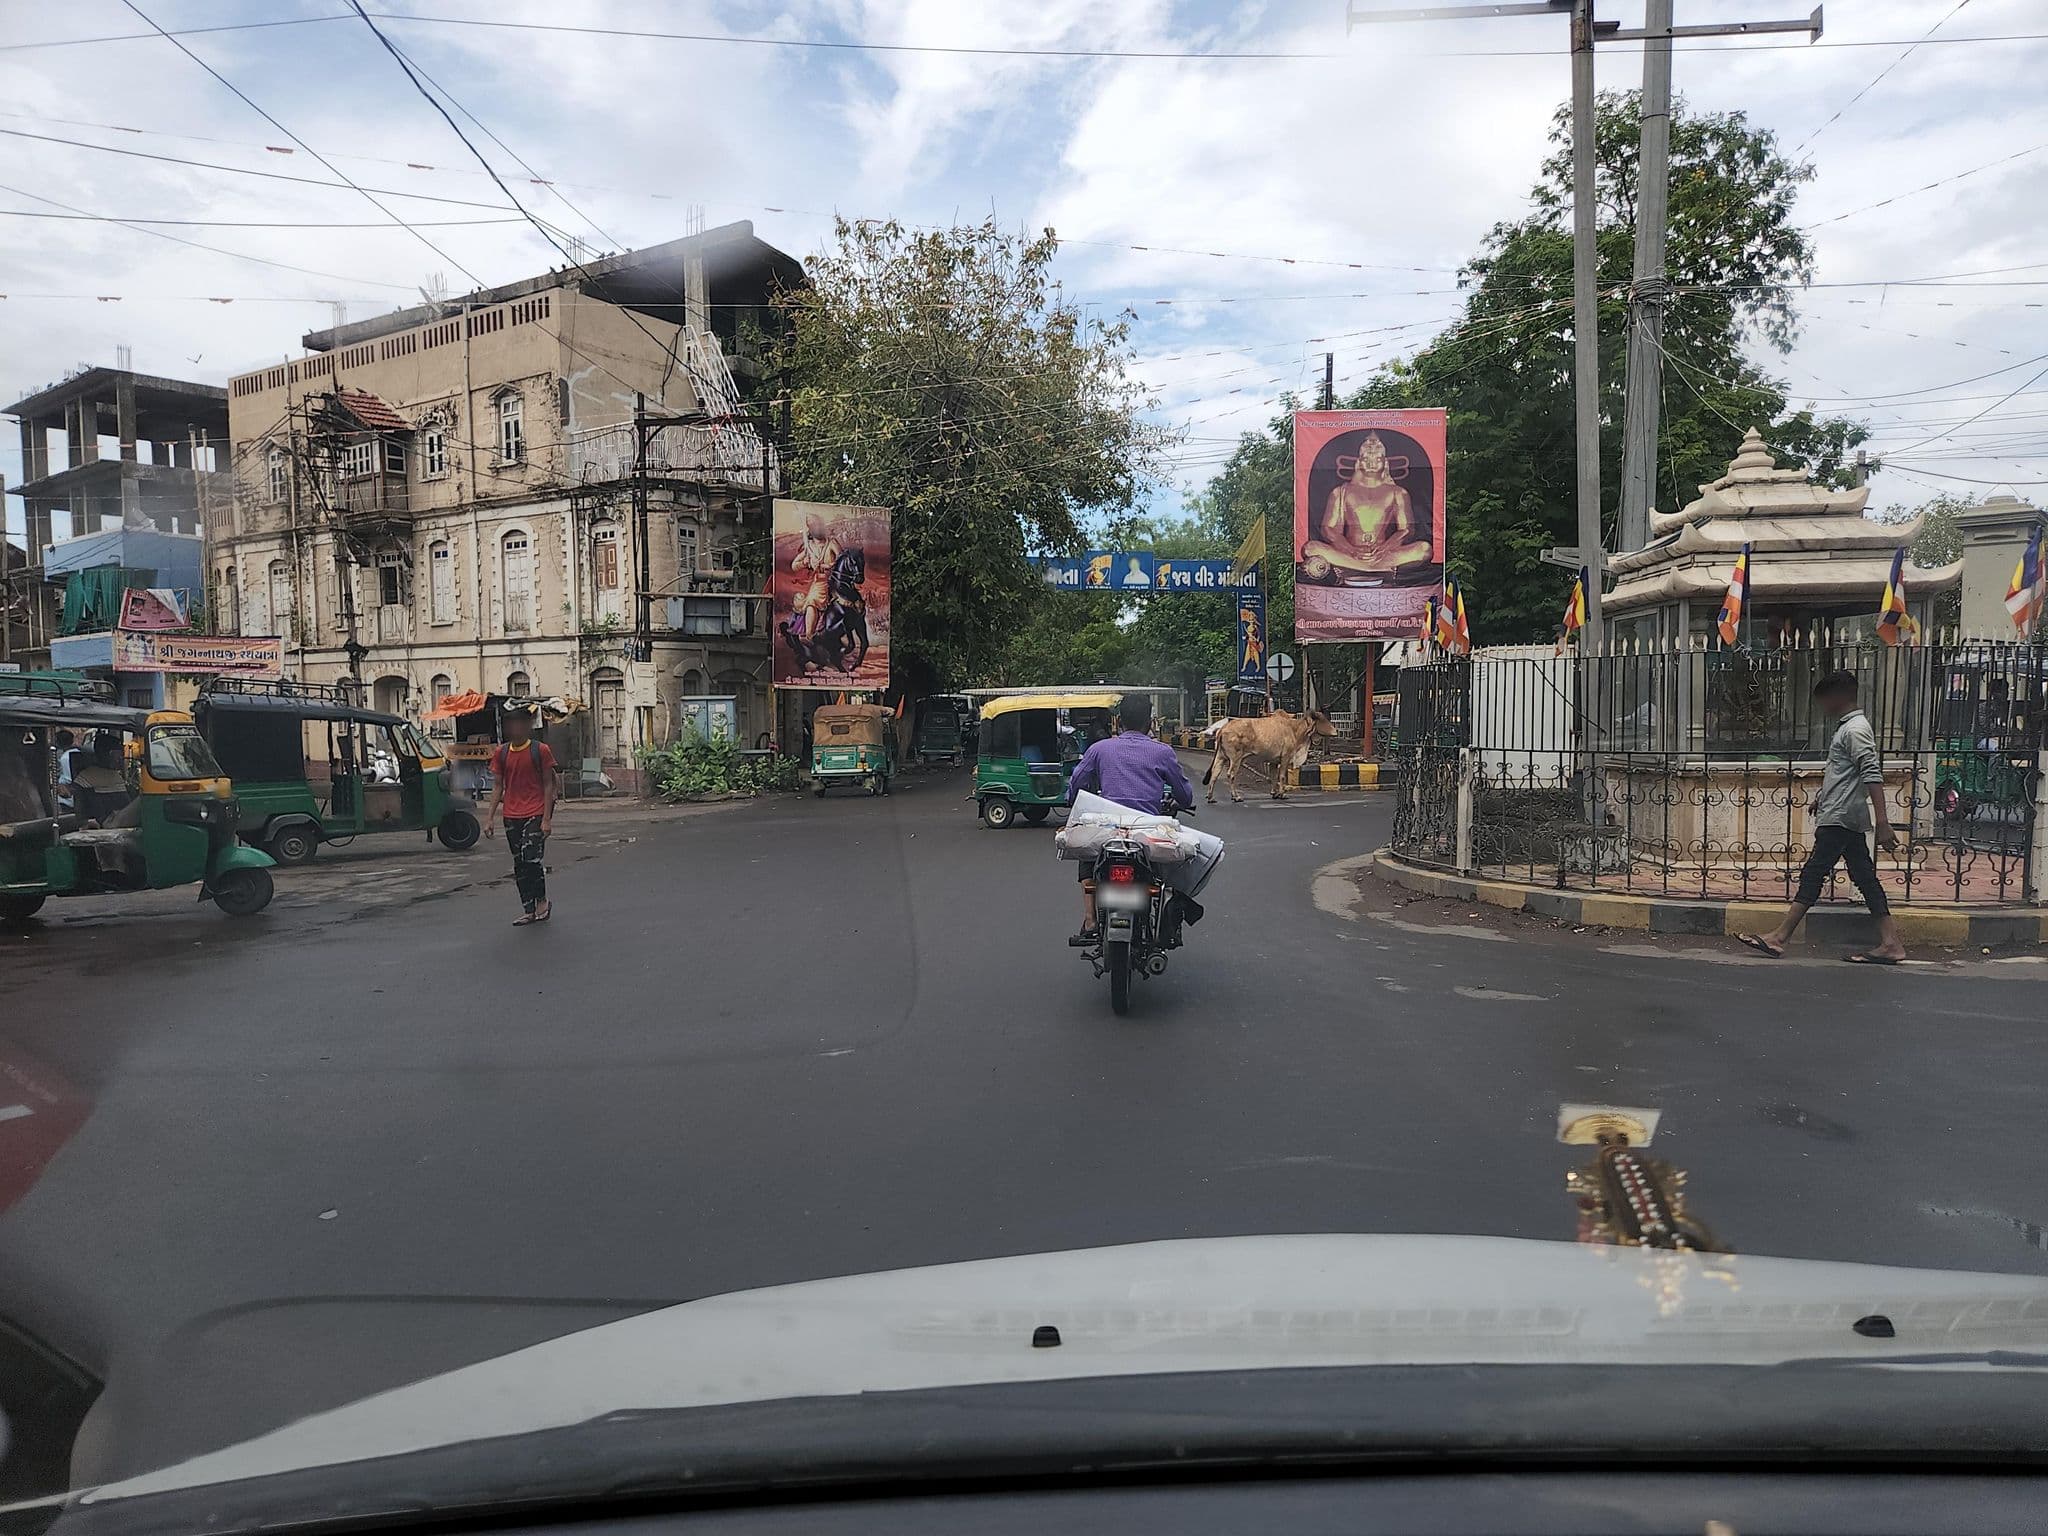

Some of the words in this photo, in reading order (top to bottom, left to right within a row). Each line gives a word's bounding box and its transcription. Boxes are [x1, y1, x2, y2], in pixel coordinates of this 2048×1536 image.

[1172, 571, 1191, 587] જય
[1194, 565, 1215, 587] વીર
[159, 644, 174, 657] શ્રી
[177, 649, 237, 661] જગન્નાથજી
[239, 651, 278, 661] રથયાત્રા
